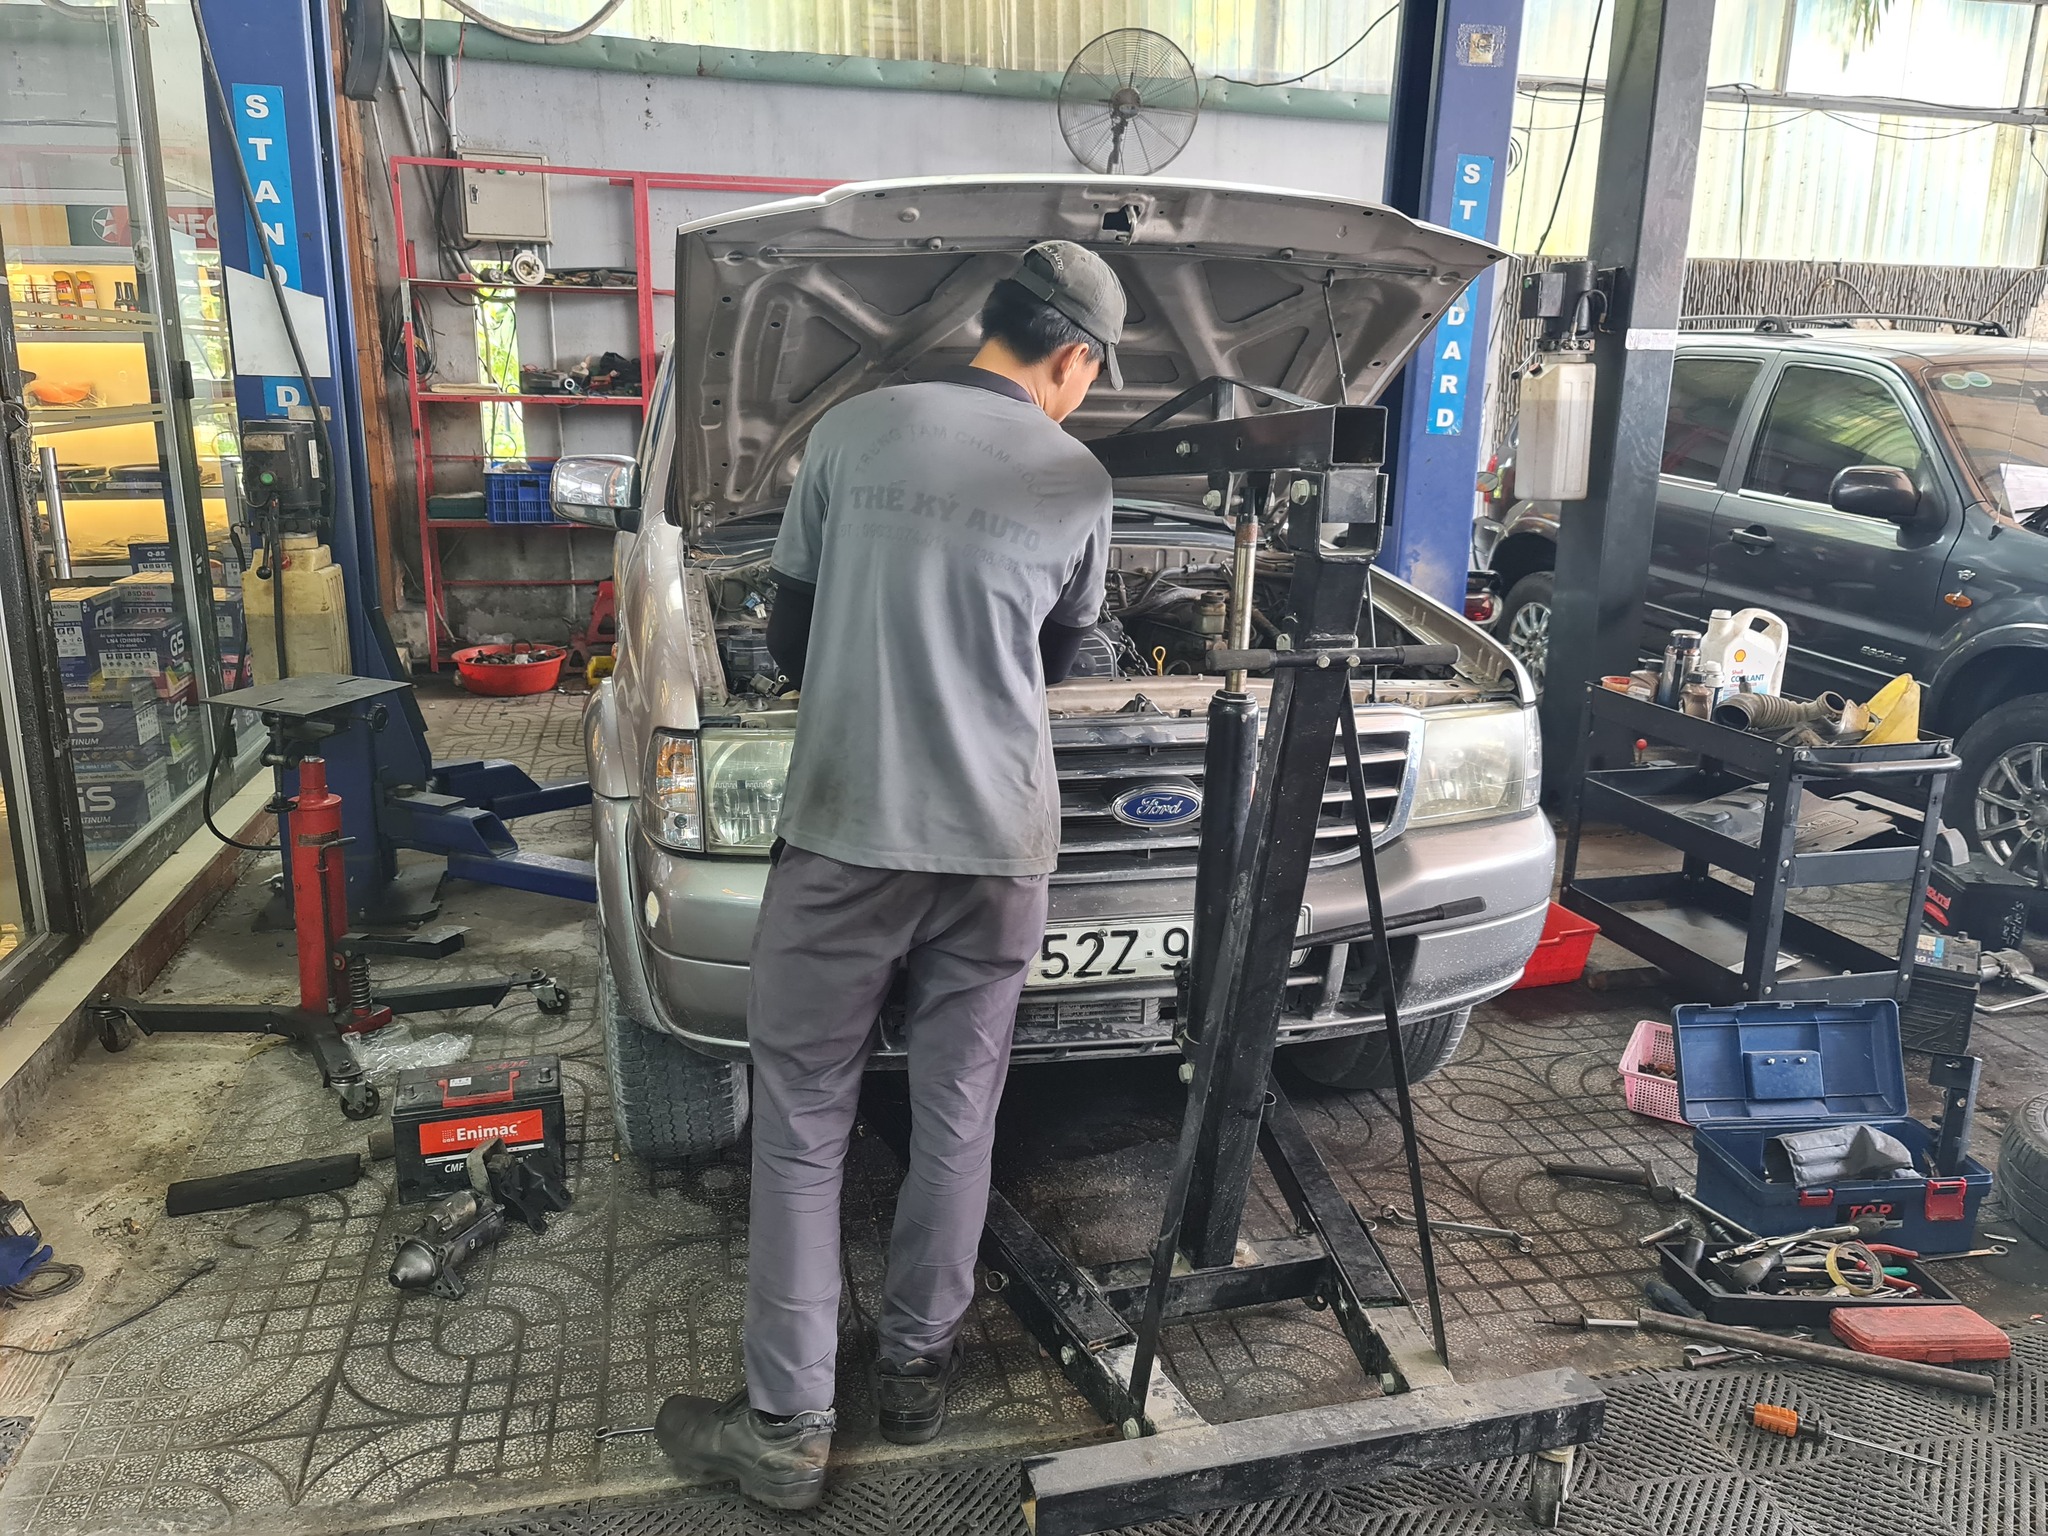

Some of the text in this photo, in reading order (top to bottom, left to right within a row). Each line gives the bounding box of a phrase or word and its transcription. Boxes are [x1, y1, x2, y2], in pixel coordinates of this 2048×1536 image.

[245, 94, 301, 408] STANDD
[1436, 163, 1481, 428] STDARD
[964, 507, 1041, 552] AUTO
[170, 630, 185, 656] GS
[1730, 674, 1765, 683] COLANT
[173, 696, 188, 724] GS
[71, 738, 99, 746] TINUM
[1136, 796, 1184, 816] Ford
[456, 1125, 518, 1141] Enimac
[444, 1162, 465, 1174] CMF
